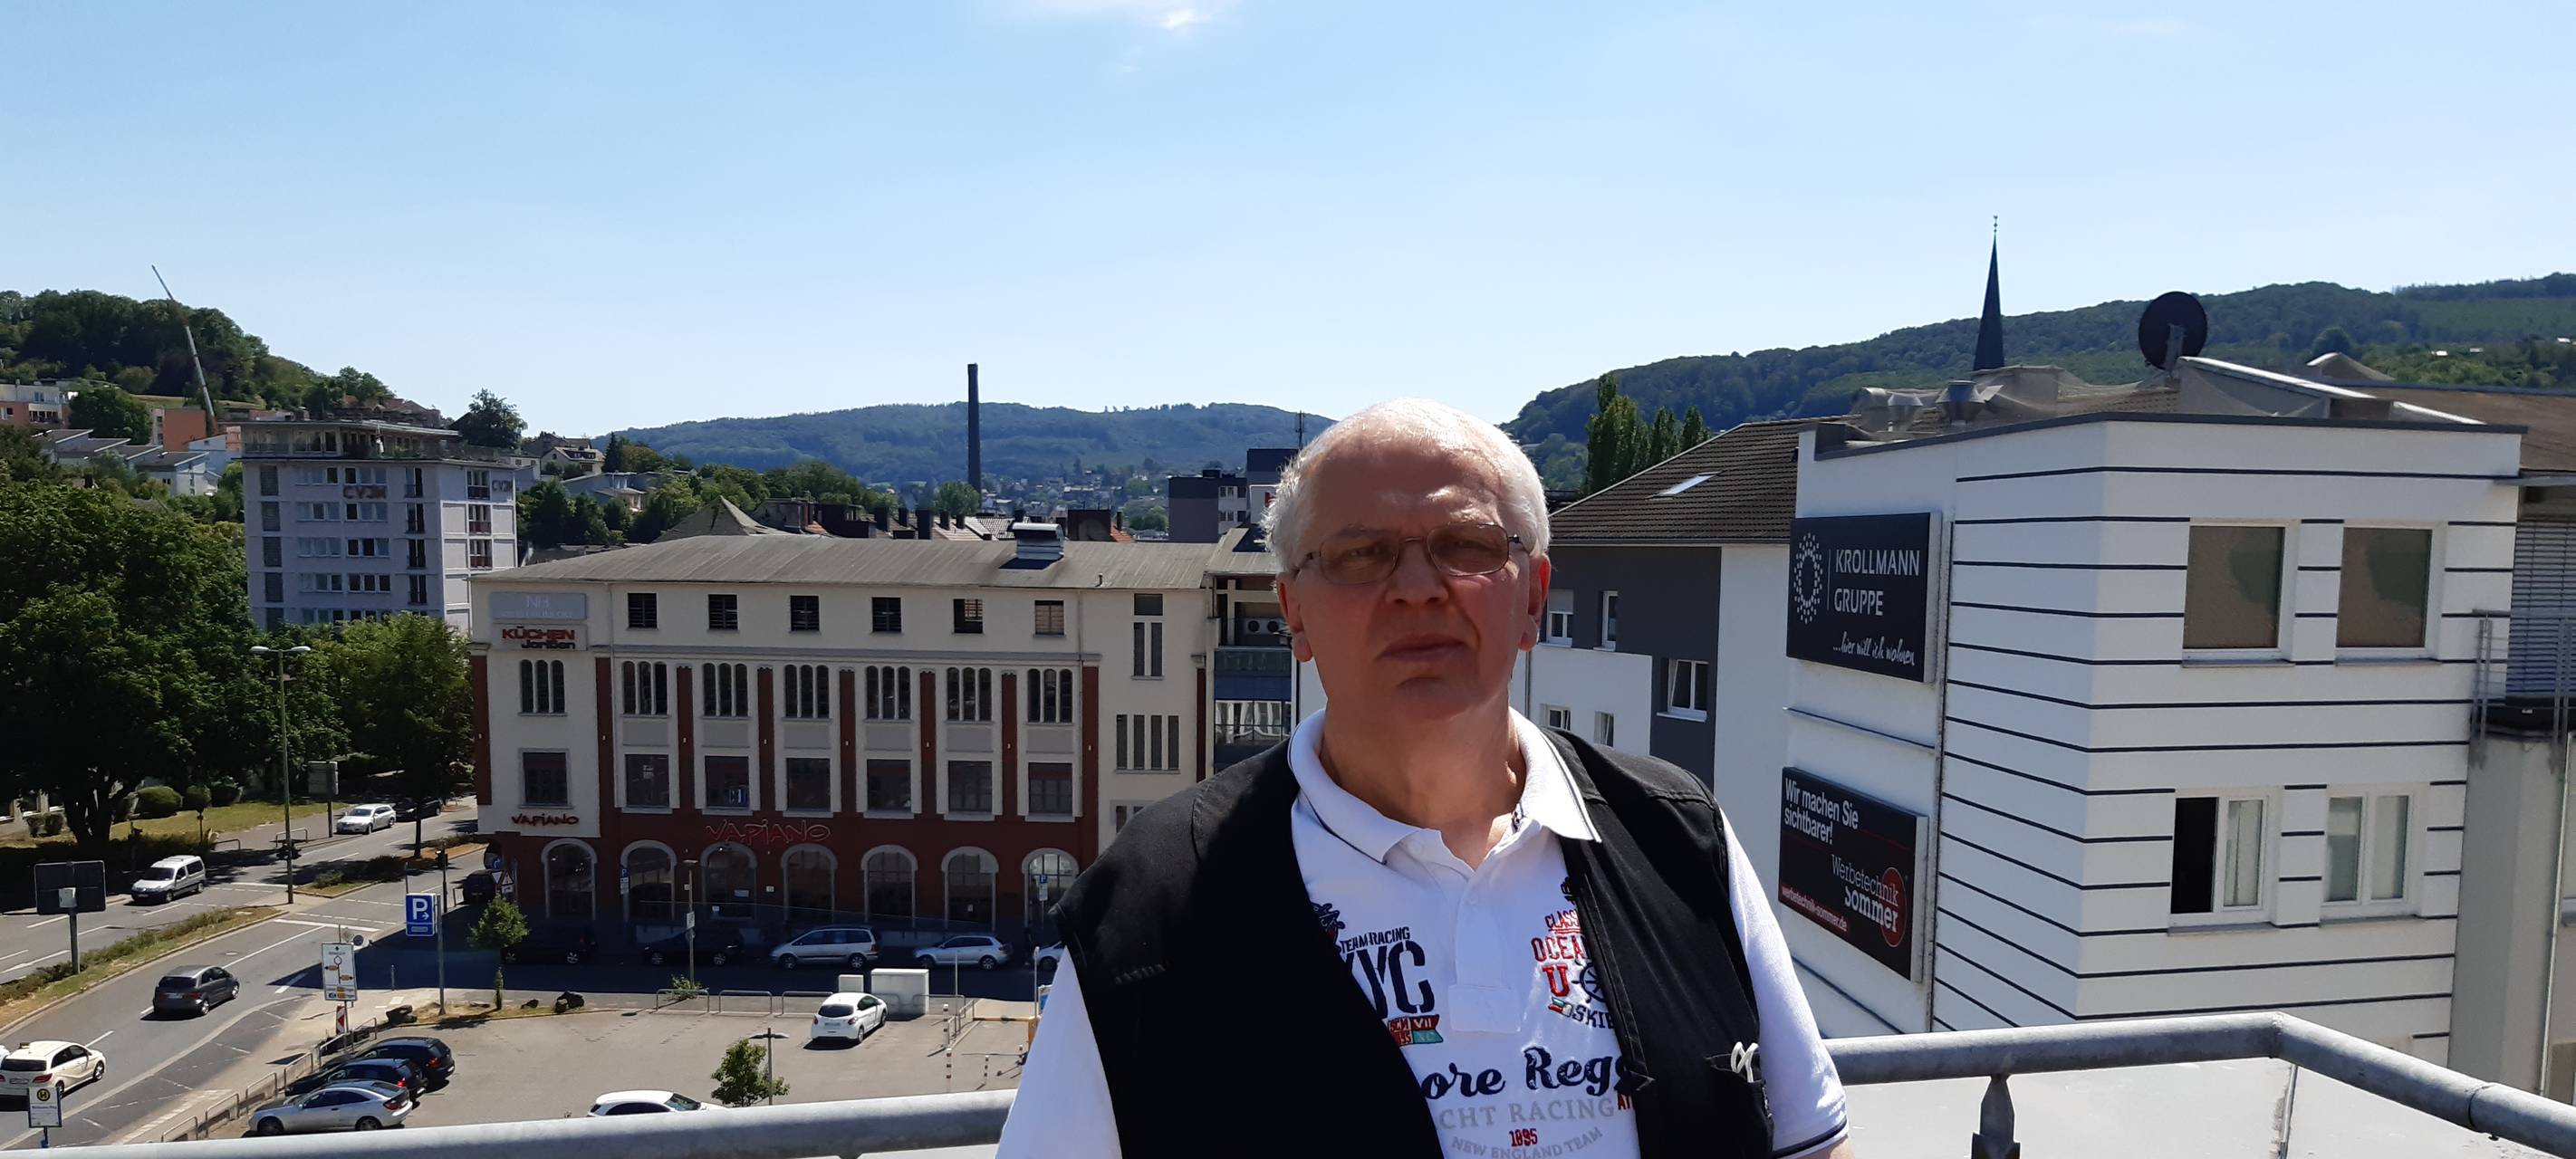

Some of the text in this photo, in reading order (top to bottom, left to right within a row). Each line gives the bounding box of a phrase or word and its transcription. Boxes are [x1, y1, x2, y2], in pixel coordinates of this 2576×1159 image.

[1835, 549, 1920, 576] KROLLMANN
[1834, 588, 1884, 616] GRUPPE
[502, 626, 575, 639] KÜCHEN
[1857, 637, 1871, 656] will
[1872, 636, 1885, 659] ich
[1886, 638, 1916, 666] wohnen
[1785, 777, 1859, 829] Wir machen Sie
[1784, 803, 1833, 845] sichtbarer!
[1831, 854, 1898, 907] Werbetechnik
[412, 897, 428, 920] P
[1544, 908, 1581, 929] CLASS
[1844, 886, 1898, 933] Sommer
[1340, 926, 1410, 953] TEAM RACING
[1346, 940, 1436, 1019] YC
[1543, 963, 1570, 998] U
[1420, 1046, 1624, 1099] ore Reg
[1440, 1098, 1615, 1130] CHT RACING
[1451, 1136, 1488, 1156] NEW
[1564, 1126, 1603, 1153] TEAM
